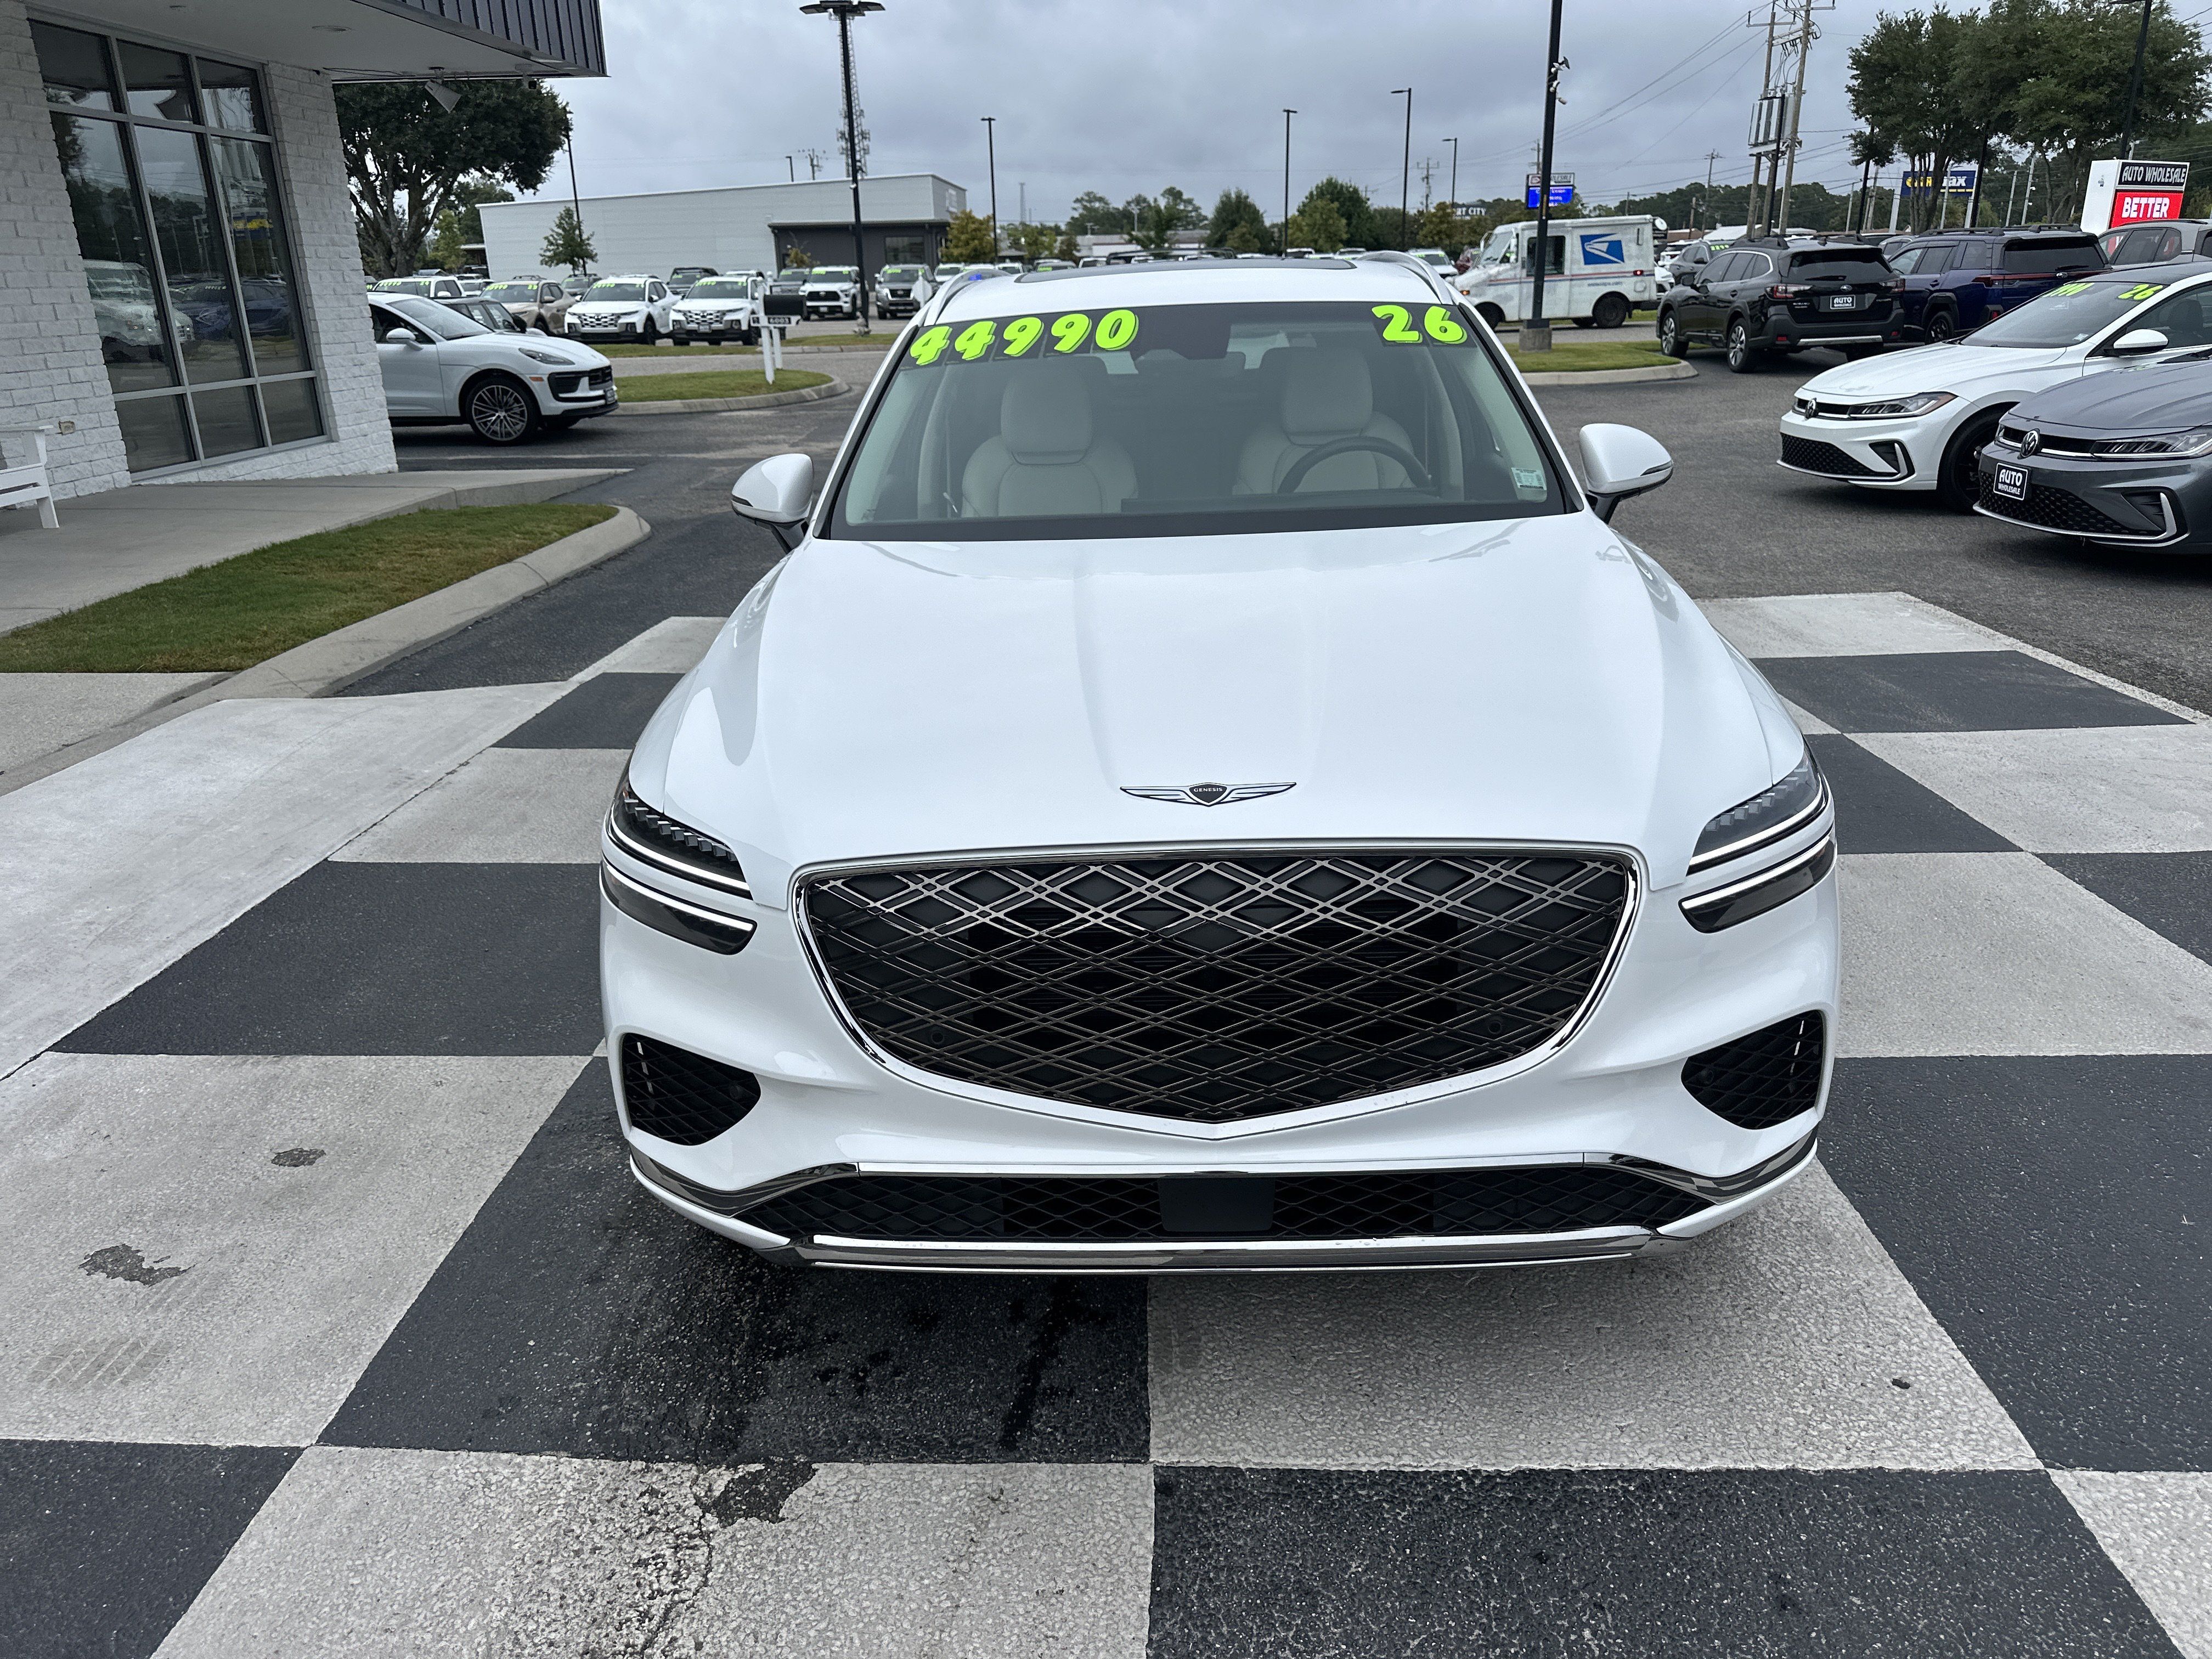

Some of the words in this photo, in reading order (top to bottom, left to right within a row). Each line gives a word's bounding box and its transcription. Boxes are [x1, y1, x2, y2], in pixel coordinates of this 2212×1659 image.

[2122, 166, 2144, 183] AUTO
[2145, 166, 2186, 183] WHOLESALE
[2121, 196, 2170, 218] BETTER
[2118, 284, 2163, 301] 26
[910, 309, 1139, 366] 44990
[1372, 304, 1468, 344] 26
[1999, 469, 2023, 486] AUTO
[1998, 483, 2021, 495] WHOLESALE
